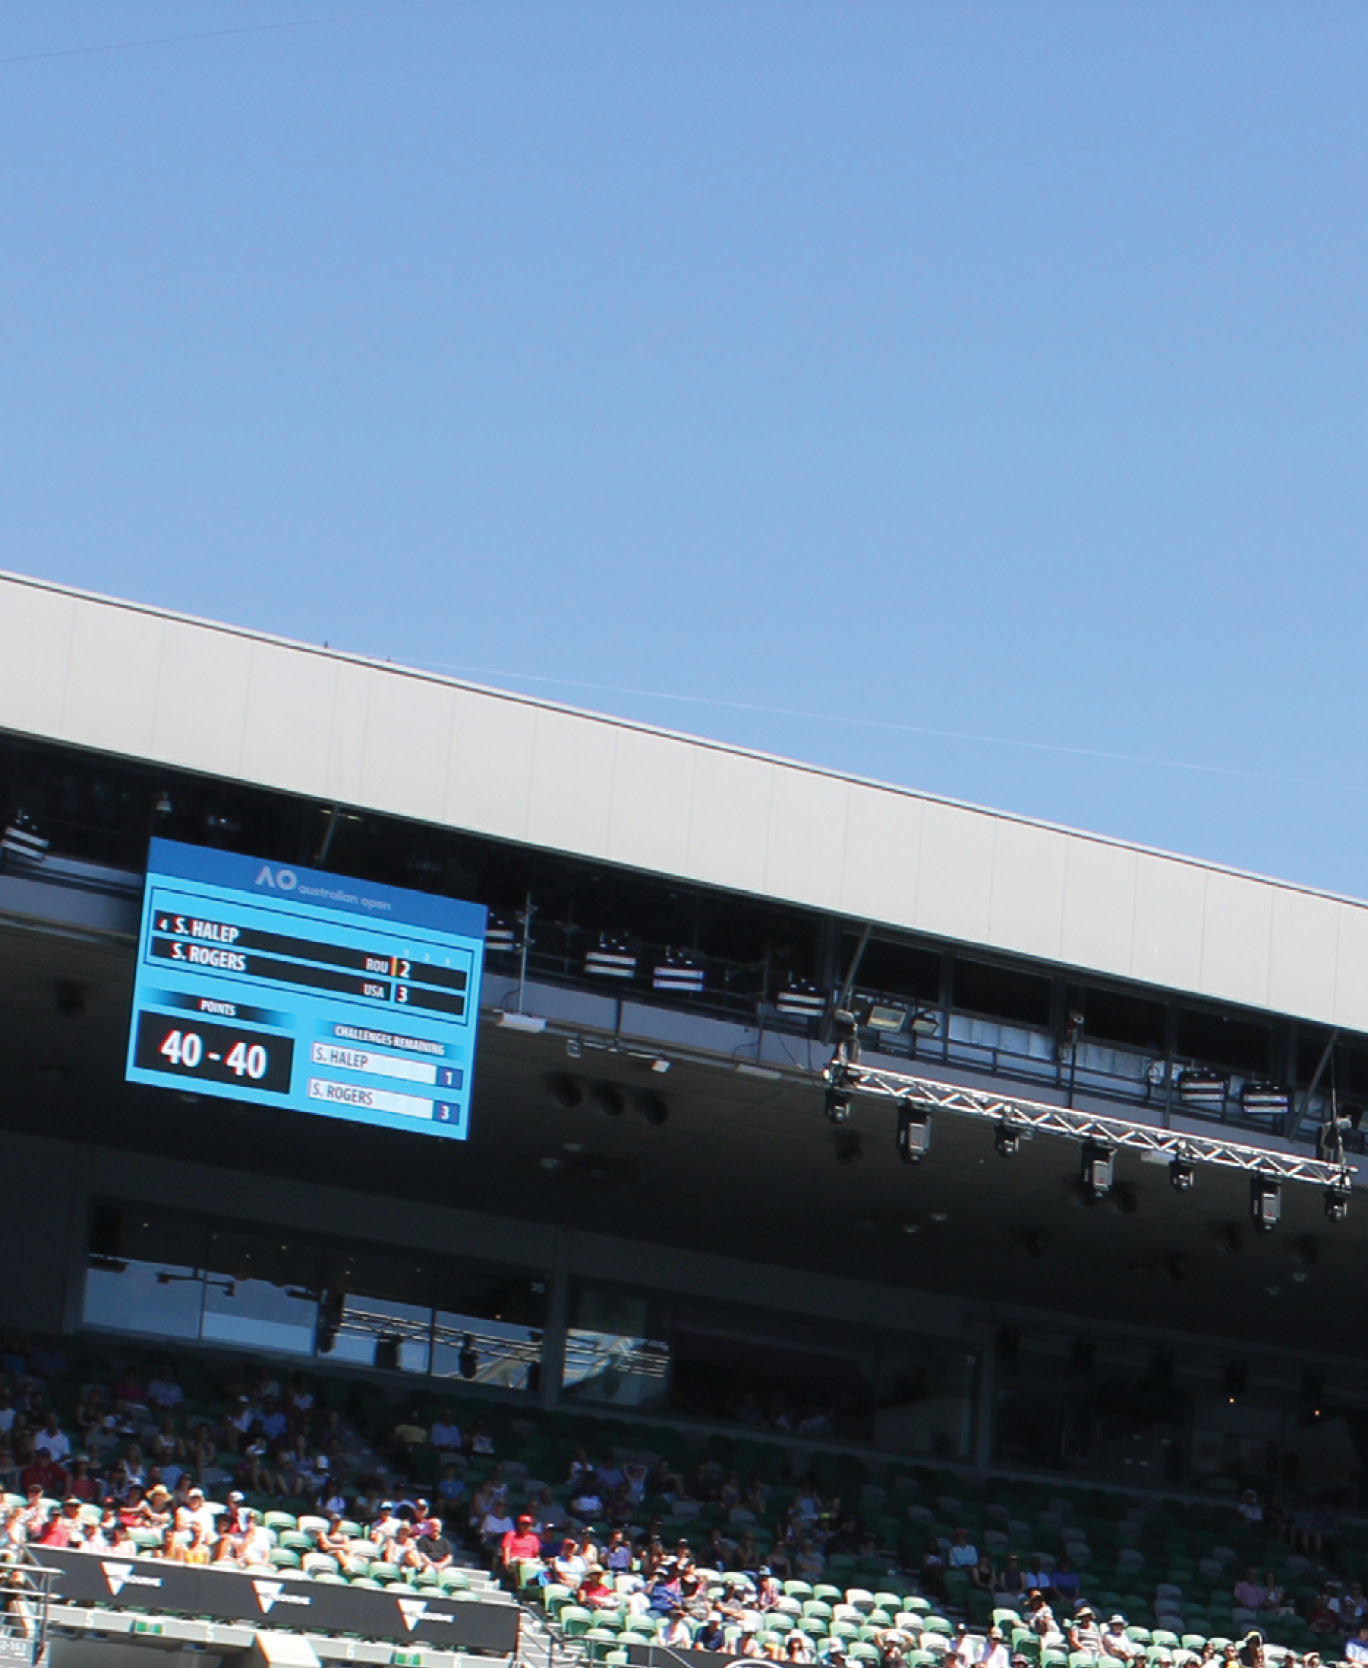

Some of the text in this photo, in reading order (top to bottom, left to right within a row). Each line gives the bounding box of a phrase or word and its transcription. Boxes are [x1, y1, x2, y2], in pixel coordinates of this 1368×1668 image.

[255, 865, 297, 890] AO
[159, 916, 239, 944] 4 S. HALEP
[171, 942, 246, 971] S. ROGERS
[365, 957, 410, 978] ROU 2
[363, 982, 408, 1003] USA 3
[200, 999, 236, 1016] POINTS
[159, 1029, 202, 1068] 40
[224, 1041, 268, 1079] 40
[334, 1024, 445, 1056] CHALLENGES REMAINING
[315, 1047, 453, 1085] S. HALEP 1
[312, 1083, 450, 1120] S. ROGERS 3
